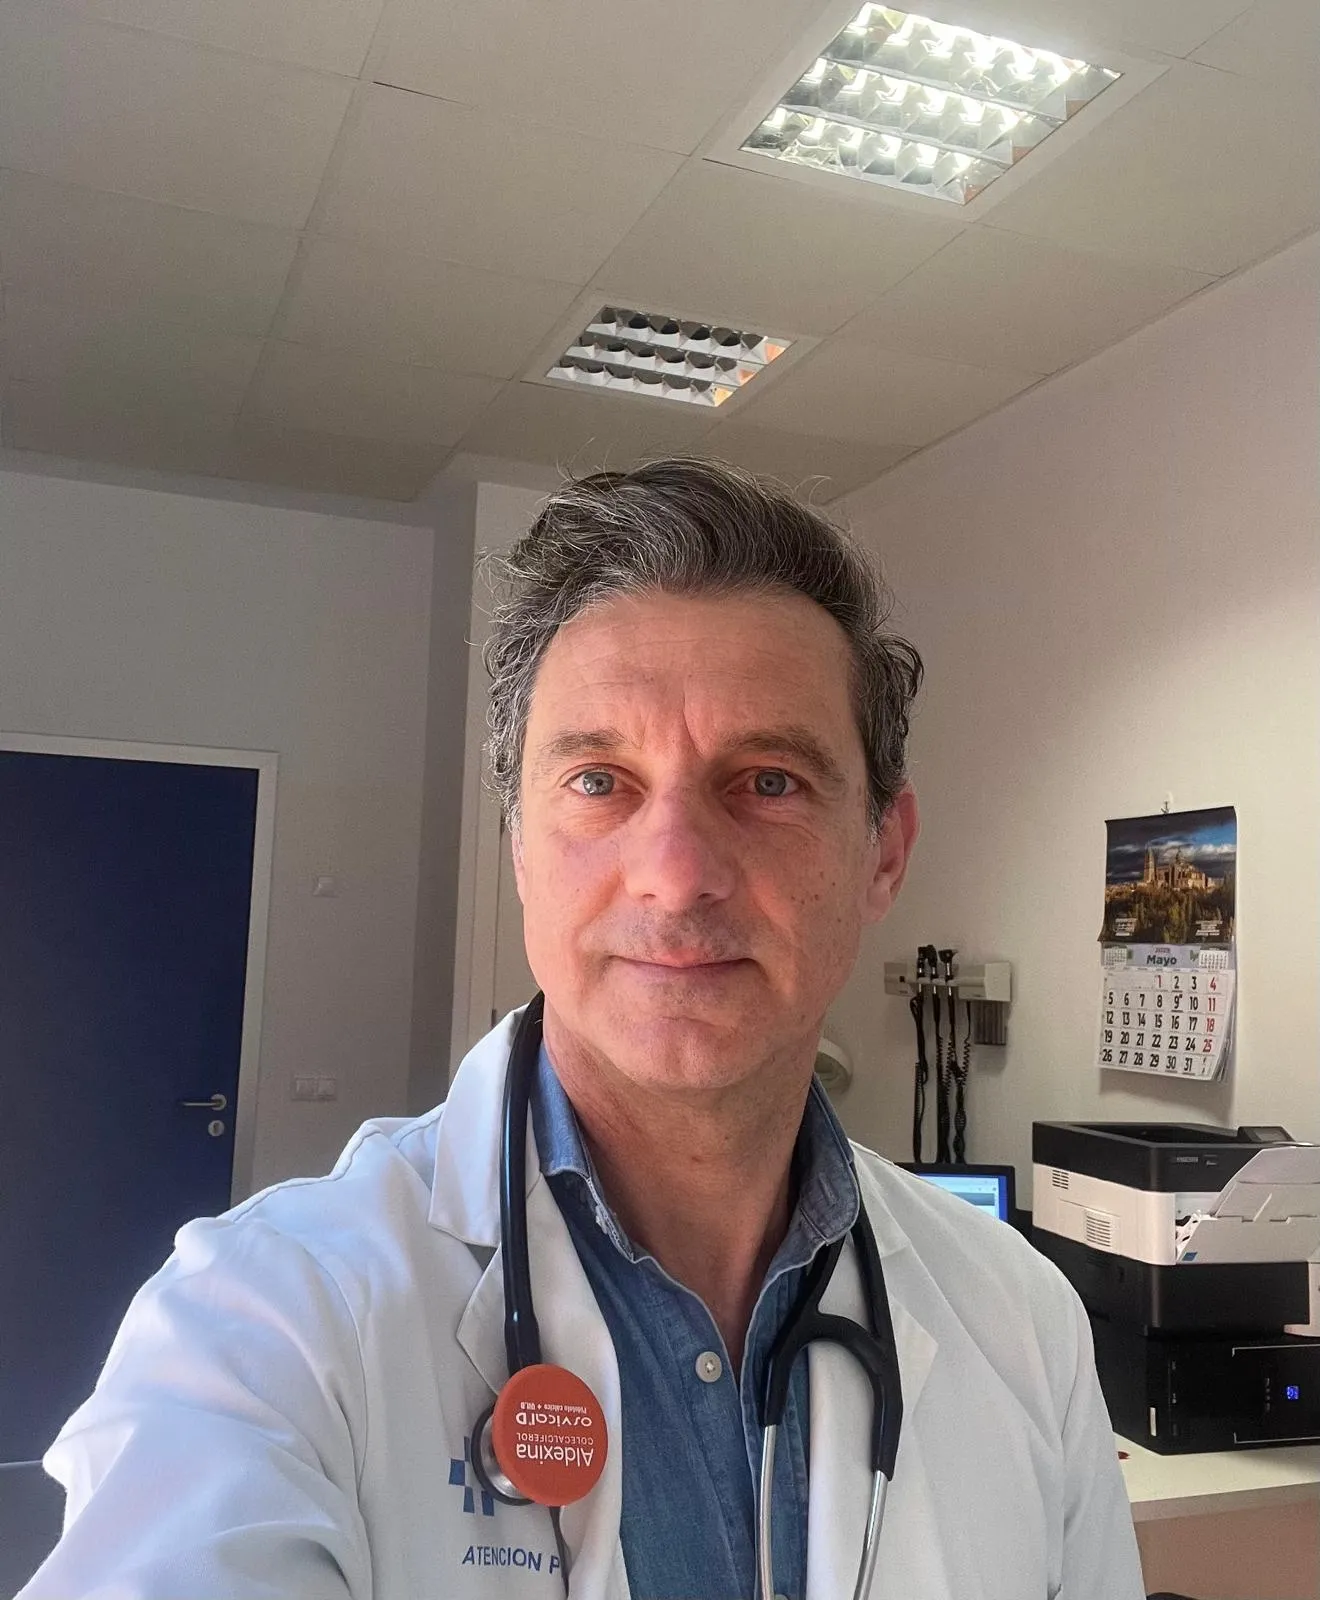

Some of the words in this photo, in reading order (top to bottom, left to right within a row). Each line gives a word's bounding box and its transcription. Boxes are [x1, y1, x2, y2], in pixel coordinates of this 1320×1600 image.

[1146, 955, 1177, 967] Mayo
[1157, 975, 1162, 988] 1
[1174, 976, 1180, 989] 2
[1191, 976, 1197, 990] 3
[1210, 977, 1217, 991] 4
[1108, 992, 1114, 1005] 5
[1124, 993, 1129, 1006] 6
[1140, 994, 1145, 1007] 7
[1157, 995, 1162, 1008] 8
[1174, 996, 1180, 1009] 9
[1190, 996, 1198, 1010] 10
[1208, 998, 1216, 1012] 11
[1106, 1011, 1113, 1024] 12
[1122, 1012, 1130, 1025] 13
[1137, 1013, 1146, 1027] 14
[1154, 1014, 1162, 1028] 15
[1171, 1015, 1180, 1030] 16
[1189, 1016, 1198, 1031] 17
[1206, 1018, 1215, 1032] 18
[1104, 1030, 1112, 1043] 19
[1120, 1031, 1129, 1045] 20
[1136, 1033, 1144, 1046] 21
[1151, 1034, 1161, 1048] 22
[1168, 1036, 1178, 1049] 23
[1185, 1037, 1196, 1052] 24
[1202, 1039, 1212, 1053] 25
[1102, 1049, 1112, 1062] 26
[1119, 1051, 1128, 1064] 27
[1133, 1052, 1143, 1065] 28
[1149, 1054, 1159, 1067] 29
[1166, 1055, 1177, 1069] 30
[1184, 1057, 1193, 1072] 31
[516, 1432, 594, 1445] COLECALCIFEROL
[516, 1443, 594, 1467] Aldexina
[462, 1545, 542, 1572] ATENCION
